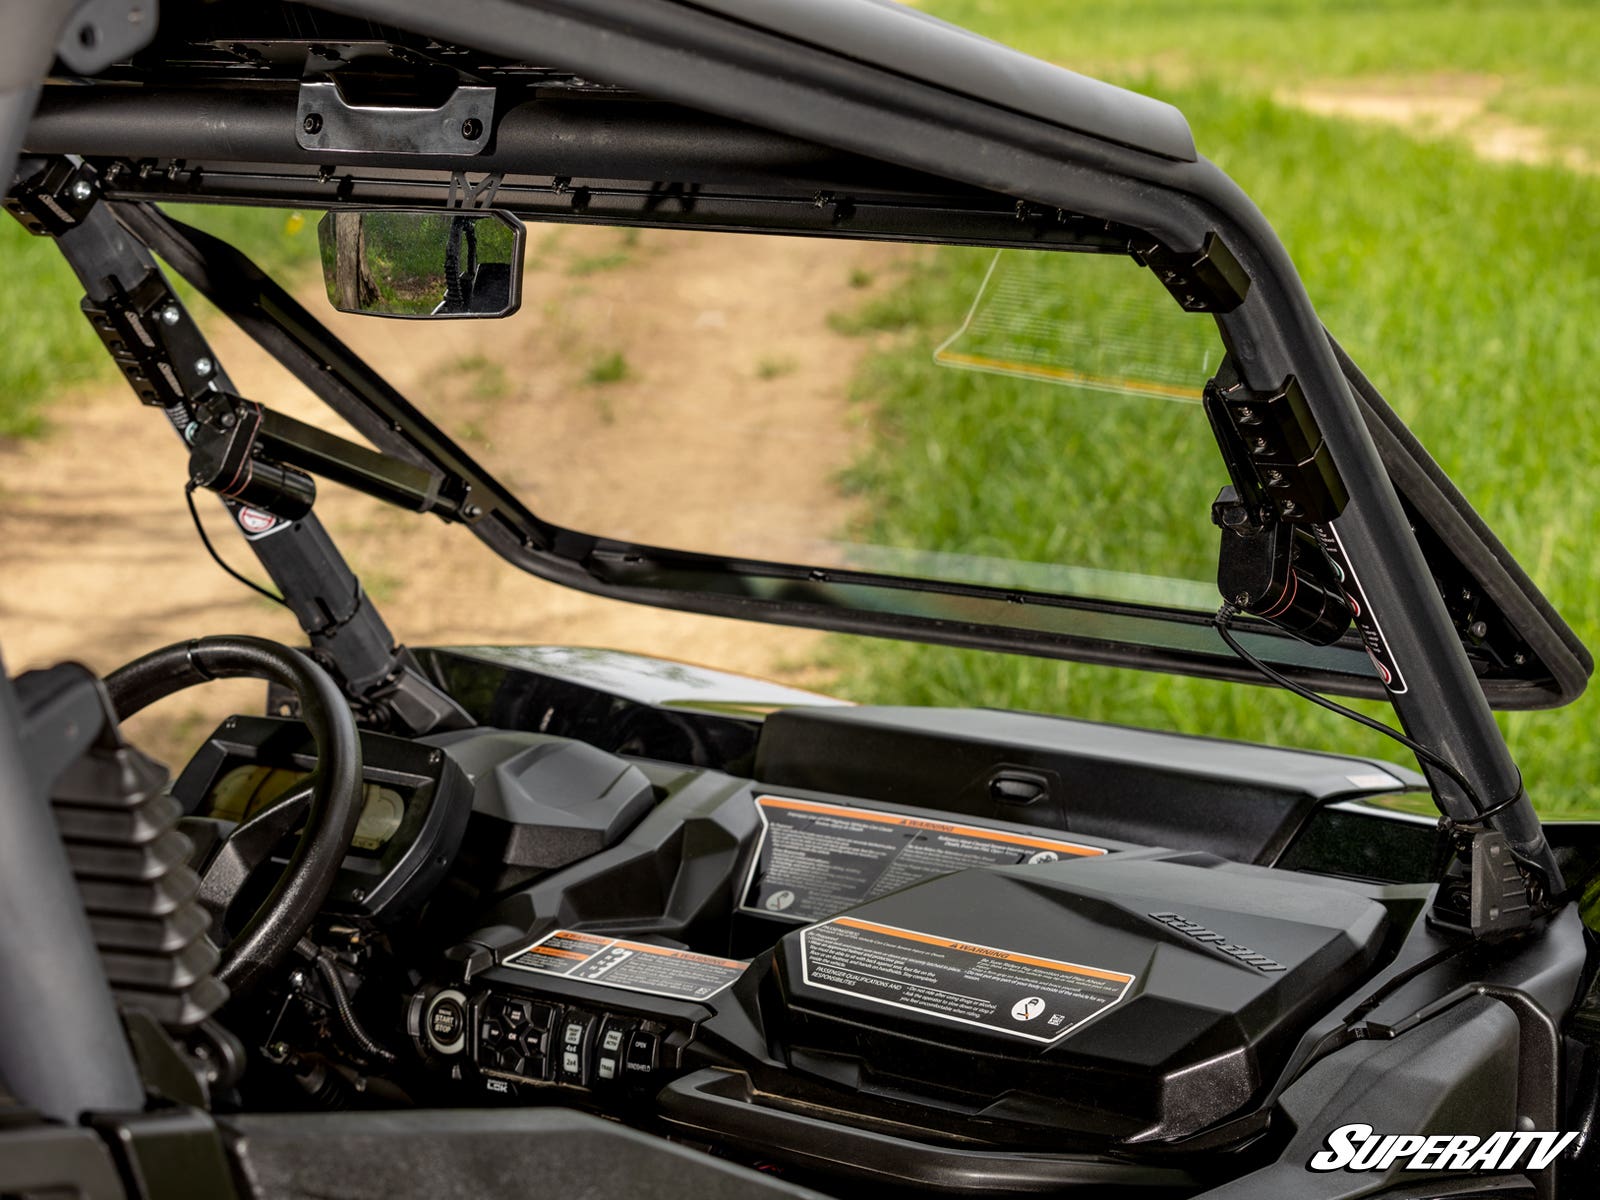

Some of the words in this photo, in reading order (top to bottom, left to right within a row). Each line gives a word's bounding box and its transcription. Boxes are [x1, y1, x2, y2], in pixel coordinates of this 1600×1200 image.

[960, 943, 1010, 959] WARNING
[815, 966, 847, 977] PASSENGER
[846, 973, 890, 986] QUALIFICATIONS
[635, 1041, 647, 1049] OPEN
[566, 1058, 576, 1067] 2x4
